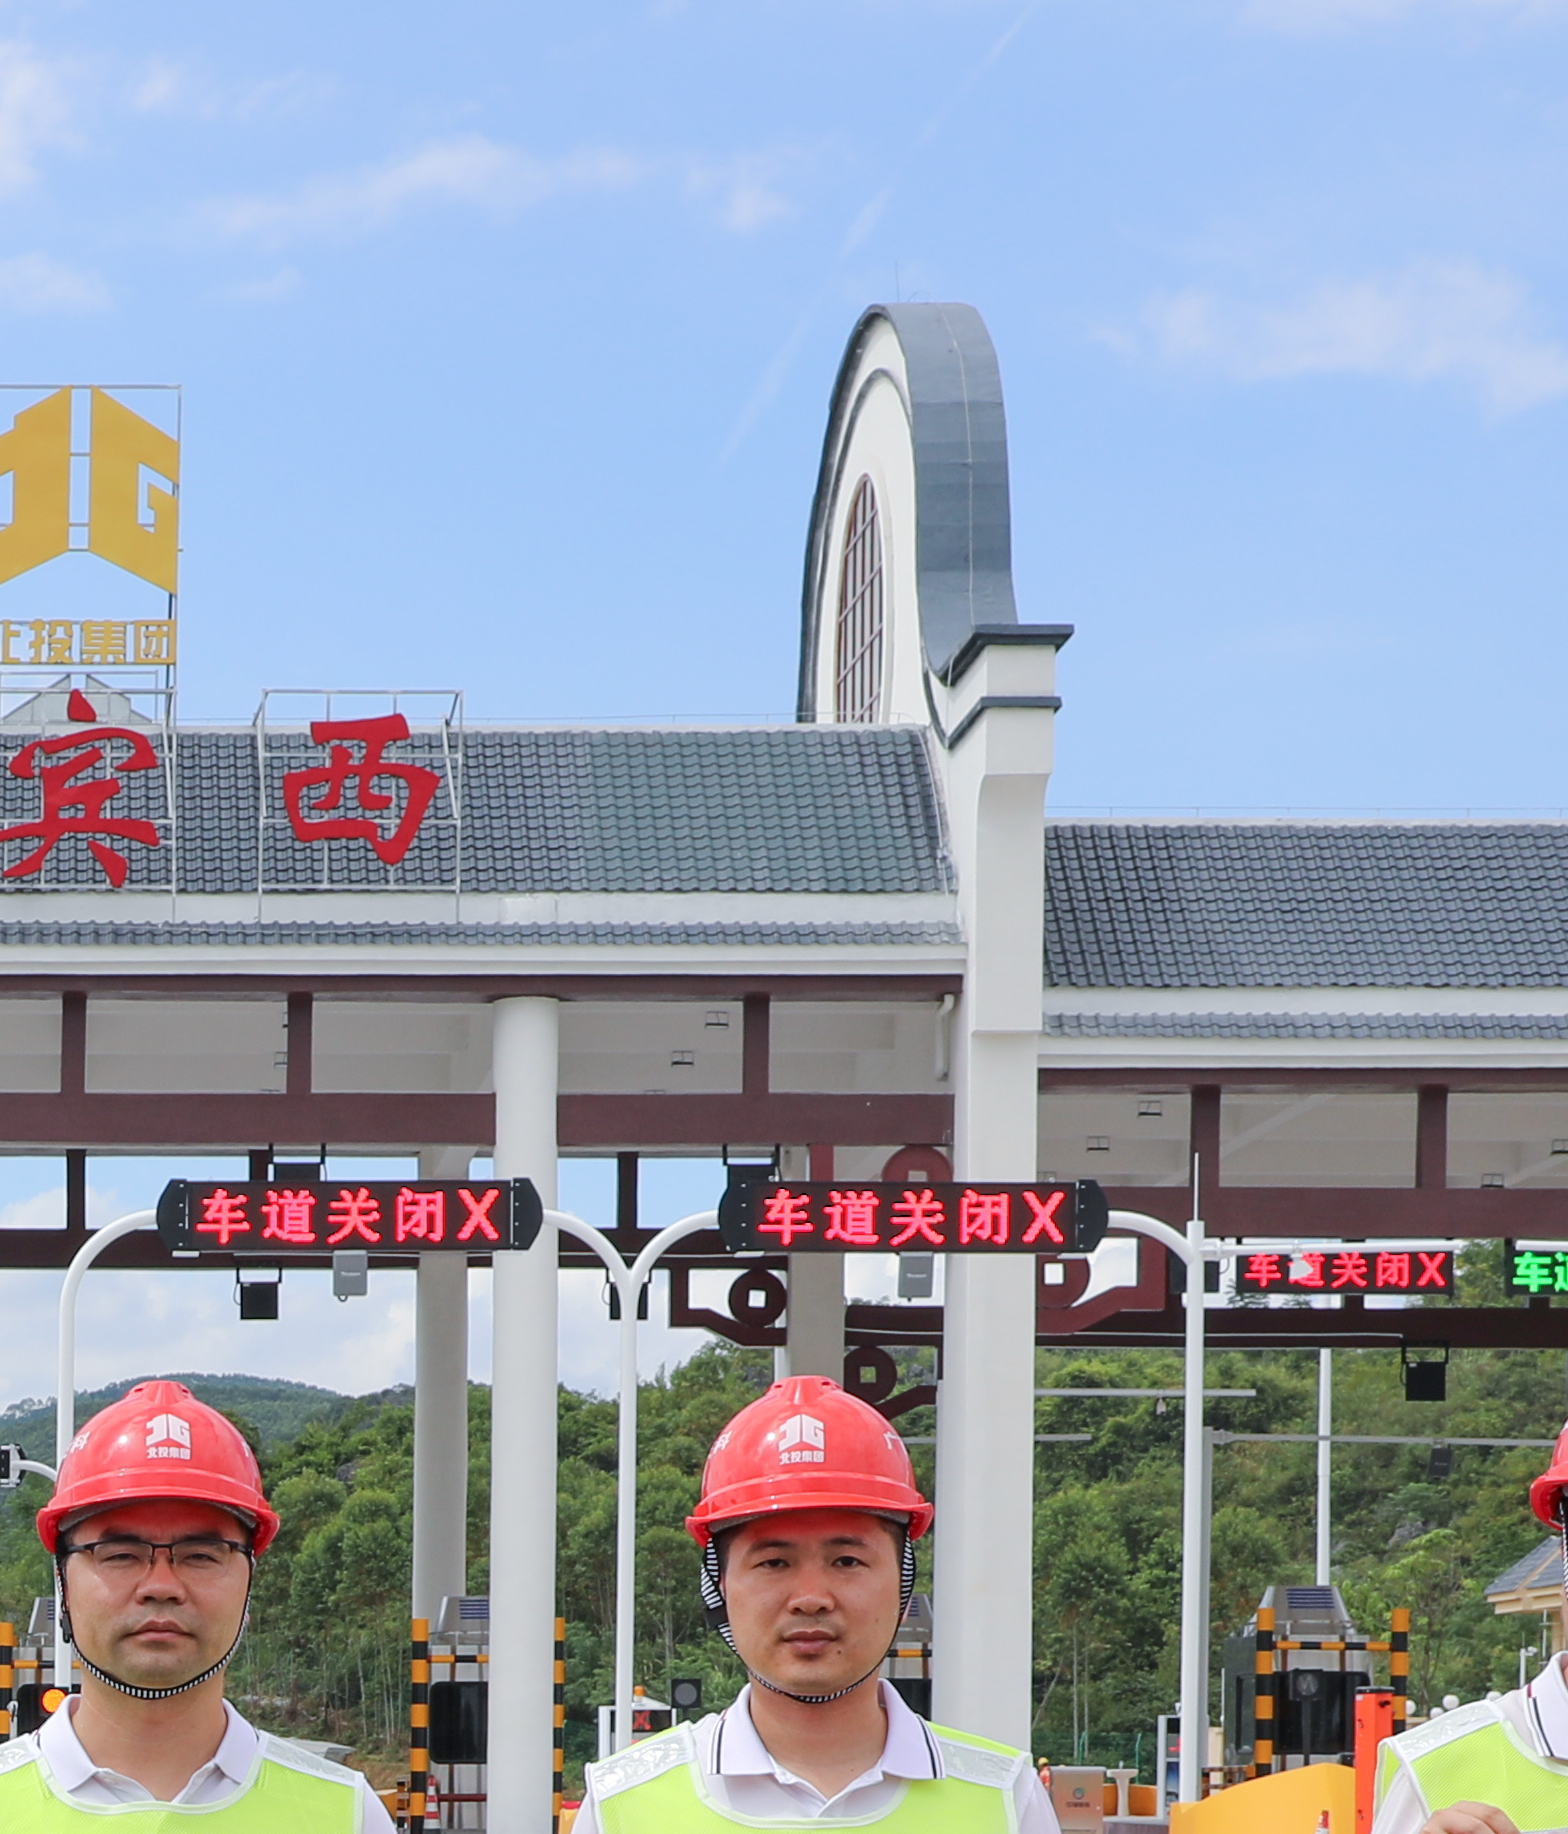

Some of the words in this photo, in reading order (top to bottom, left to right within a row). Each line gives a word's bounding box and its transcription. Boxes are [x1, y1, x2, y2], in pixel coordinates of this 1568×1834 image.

[146, 1446, 191, 1460] 北投集团
[778, 1450, 825, 1465] 北投集团
